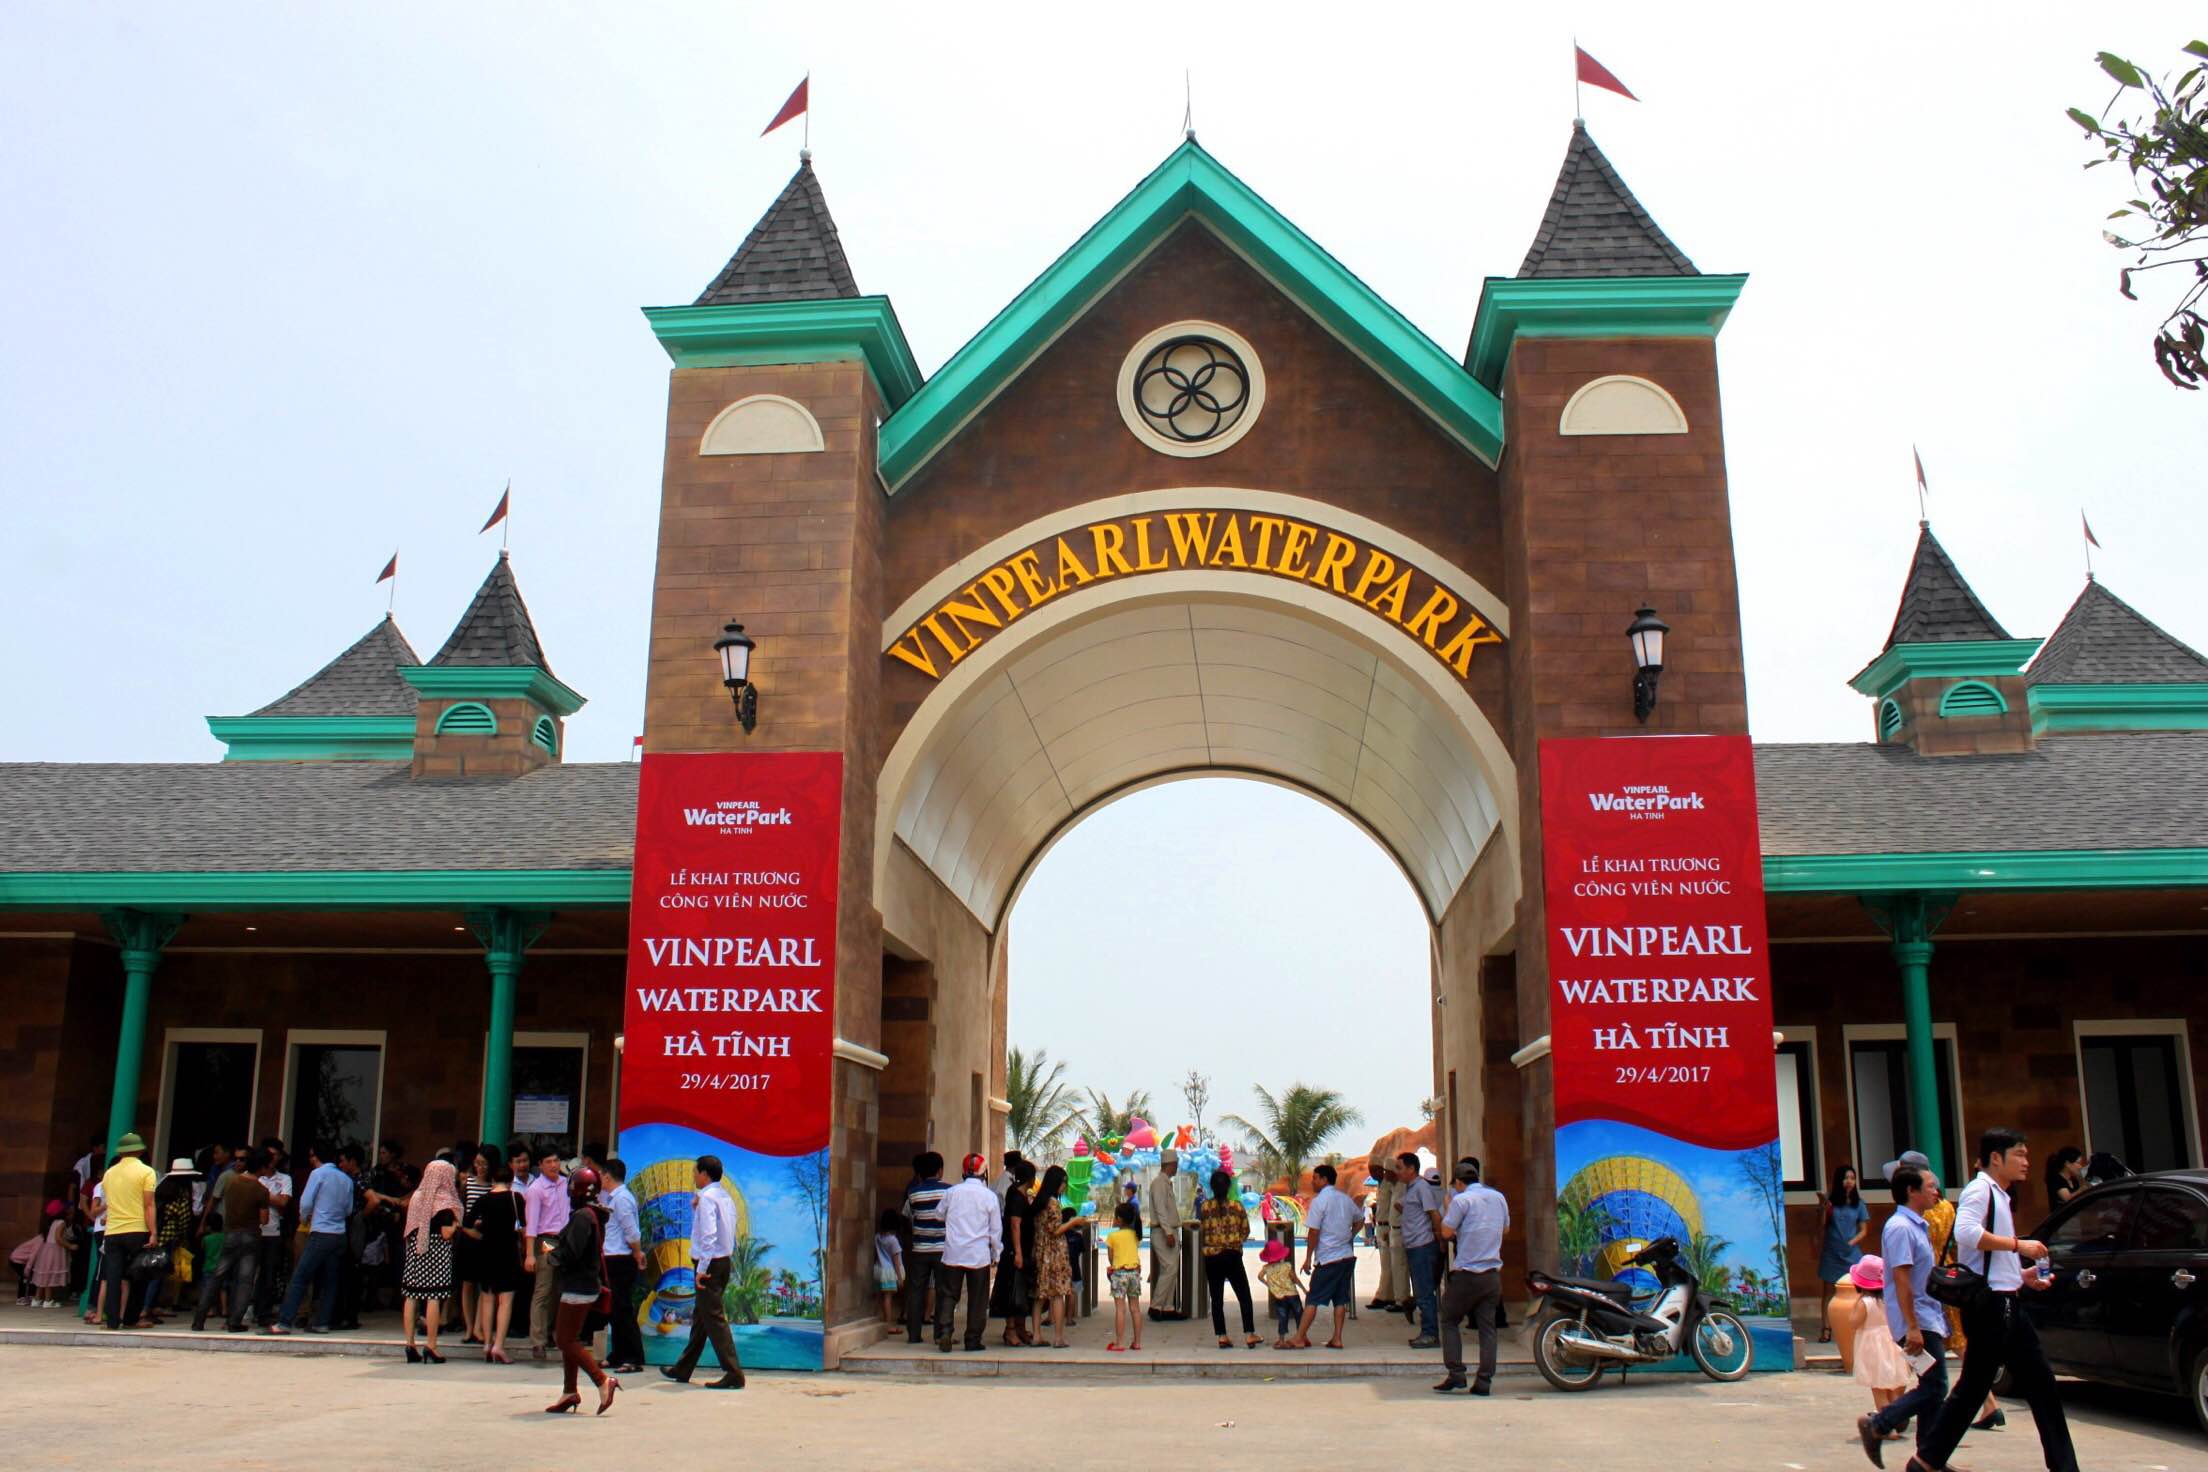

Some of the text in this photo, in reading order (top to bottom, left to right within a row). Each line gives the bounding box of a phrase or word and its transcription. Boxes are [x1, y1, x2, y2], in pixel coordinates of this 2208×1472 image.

[1623, 785, 1670, 794] VINPEARL
[716, 801, 761, 809] VINPEARL
[1604, 859, 1645, 873] KHAI
[1648, 857, 1721, 872] TRƯƠNG
[690, 872, 729, 885] KHAI
[732, 871, 801, 885] TRƯƠNG
[1573, 878, 1731, 897] CÔNG VIÊN NƯỚC
[659, 892, 808, 909] CÔNG VIÊN NƯỚC
[1560, 925, 1752, 957] VINPEARL
[643, 937, 822, 967] VINPEARL
[1558, 977, 1760, 1004] WATERPARK
[636, 987, 823, 1013] WATERPARK
[663, 1030, 791, 1058] HÀ TĨNH
[1592, 1022, 1730, 1050] HÀ TĨNH
[680, 1073, 771, 1090] 29/4/2017
[1616, 1066, 1711, 1084] 29/4/2017
